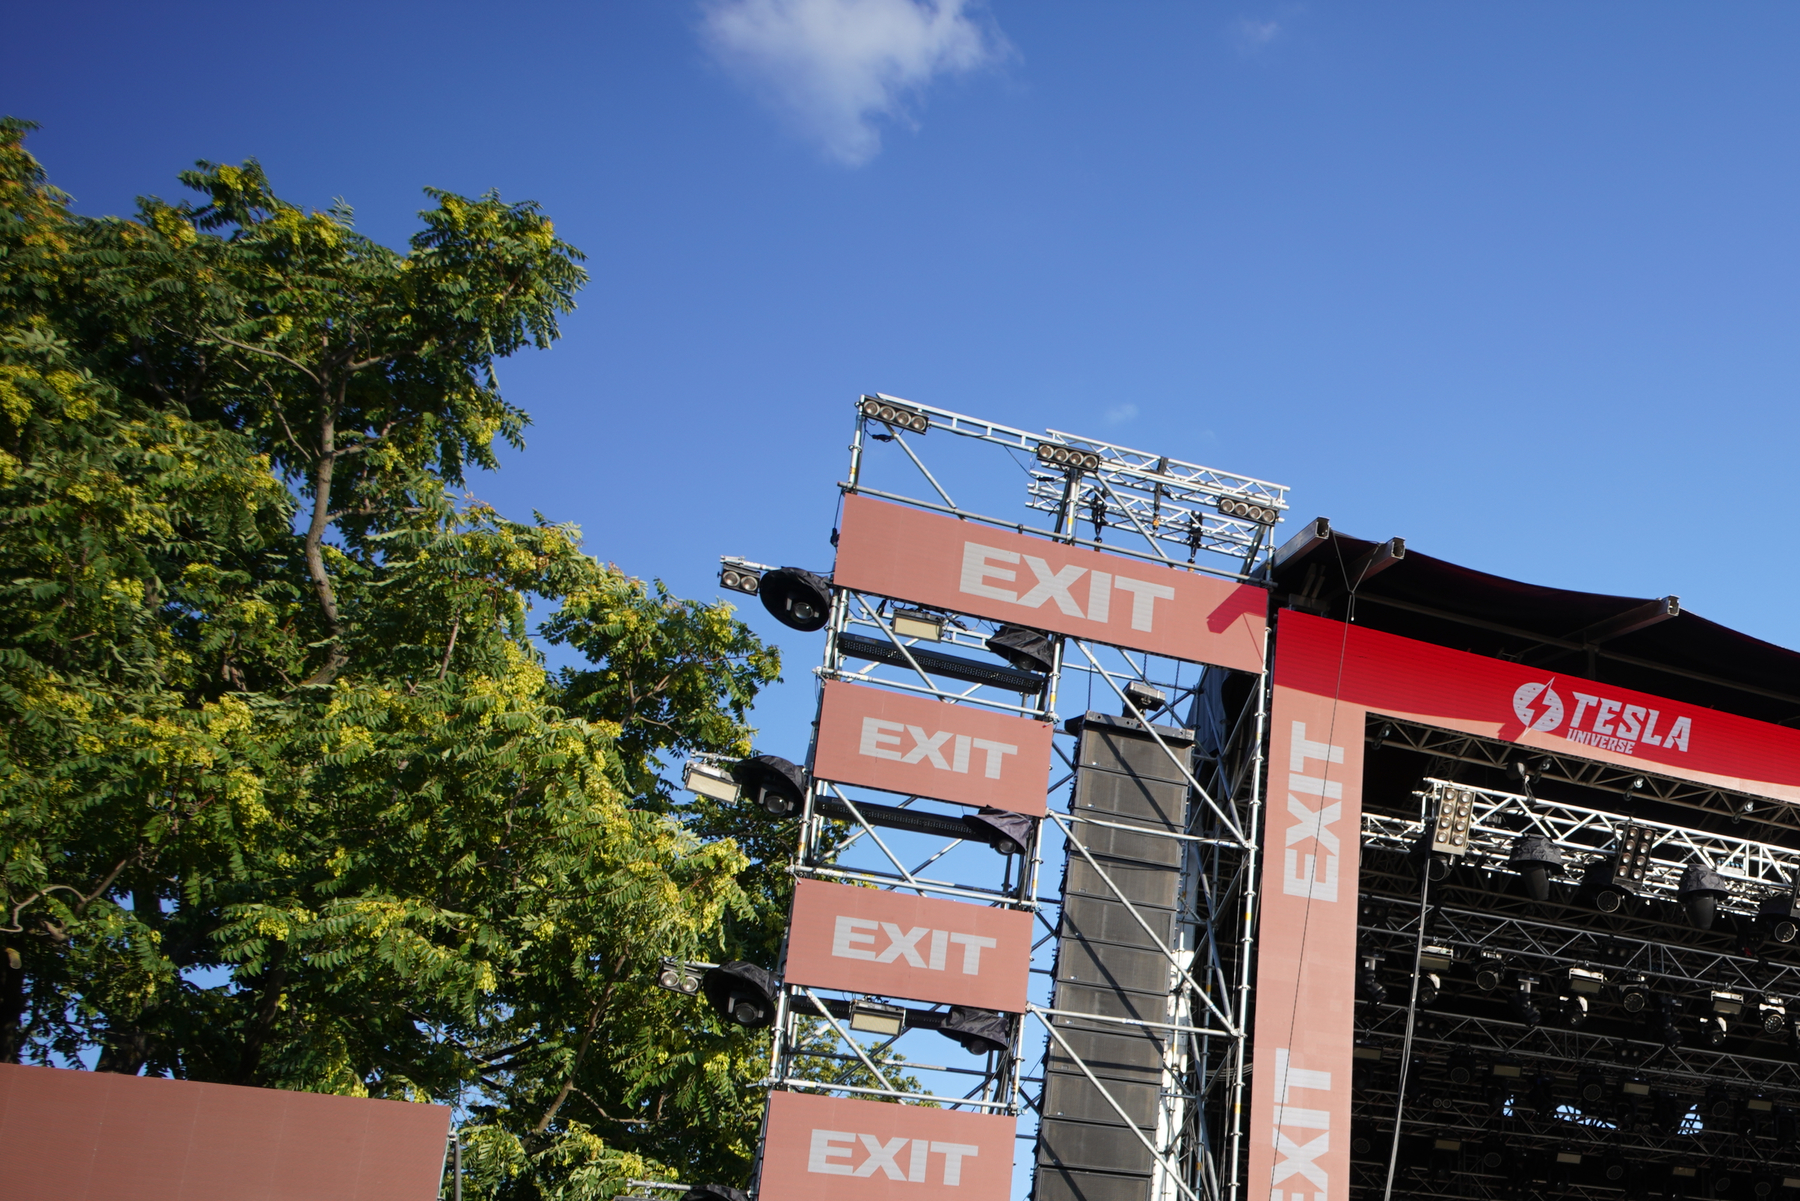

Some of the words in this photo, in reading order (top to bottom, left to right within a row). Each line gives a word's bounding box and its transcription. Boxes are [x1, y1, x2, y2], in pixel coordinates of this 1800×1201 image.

[959, 541, 1174, 633] EXIT
[858, 716, 1018, 780] EXIT
[1566, 727, 1636, 755] UNIVERSE
[1569, 691, 1692, 753] TESLA
[1283, 721, 1345, 903] EXIT
[831, 914, 997, 975] EXIT
[806, 1128, 979, 1187] EXIT
